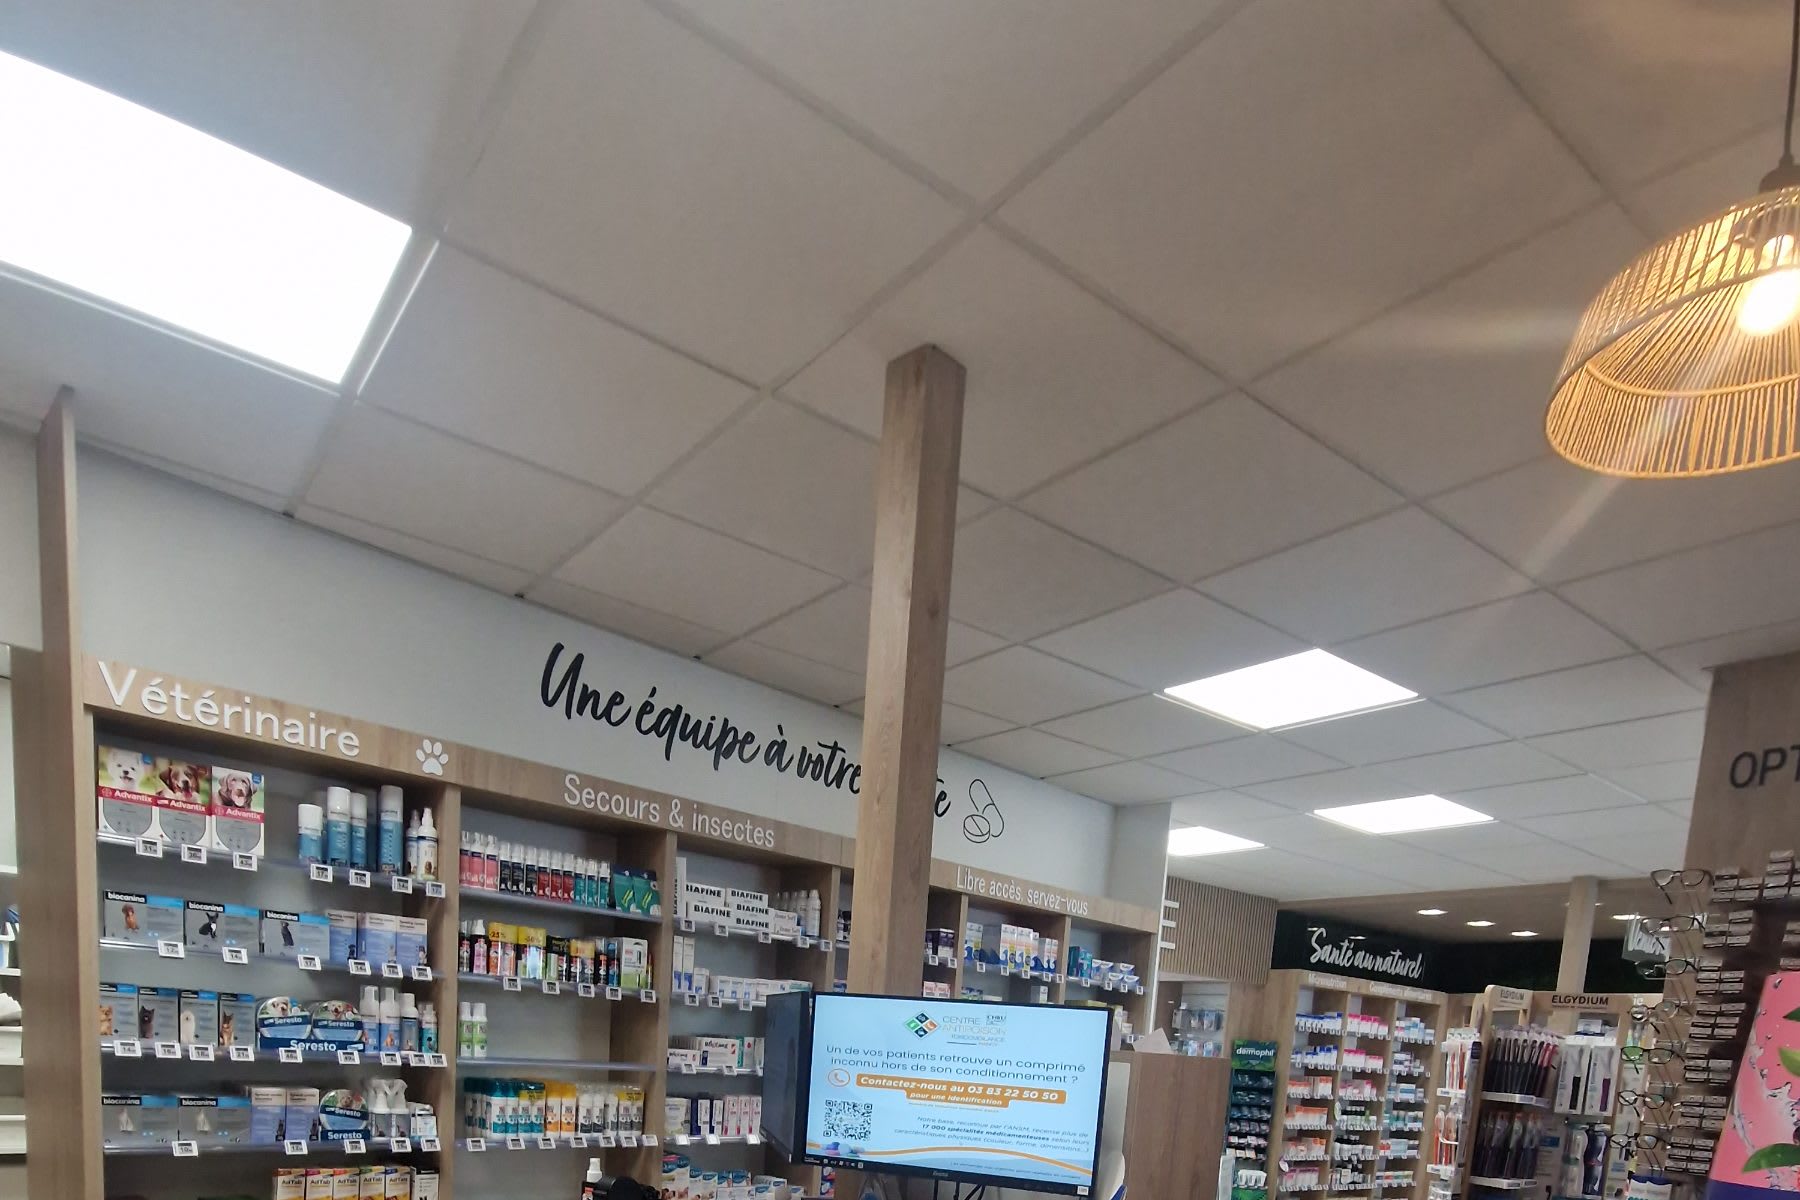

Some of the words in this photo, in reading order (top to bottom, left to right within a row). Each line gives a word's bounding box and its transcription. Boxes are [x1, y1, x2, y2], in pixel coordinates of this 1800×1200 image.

[98, 661, 361, 757] Vétérinaire
[541, 642, 632, 727] Une
[635, 686, 760, 771] équipe
[764, 724, 794, 773] à
[796, 740, 862, 794] votre
[114, 789, 153, 804] Advantix
[170, 799, 206, 813] Advantix
[564, 774, 660, 823] Secours
[669, 798, 685, 828] &
[692, 804, 775, 848] insectes
[225, 807, 261, 821] Advantix
[108, 891, 146, 903] biocanina
[731, 889, 764, 901] BIAFINE
[956, 866, 986, 892] Libre
[1027, 887, 1089, 916] servez-vous
[189, 902, 224, 913] biocanina
[693, 904, 731, 918] BIAFINE
[736, 903, 770, 916] BIAFINE
[266, 911, 298, 922] biocanina
[735, 917, 770, 929] BIAFINE
[1310, 928, 1355, 968] Santé
[1551, 994, 1609, 1006] ELGYDIUM
[274, 1016, 303, 1025] Seresto
[328, 1020, 355, 1028] Seresto
[942, 1015, 981, 1025] CENTRE
[290, 1039, 337, 1052] Seresto
[826, 1045, 841, 1054] Un
[844, 1045, 859, 1055] de
[863, 1048, 883, 1057] vos
[886, 1049, 936, 1061] patients
[939, 1054, 992, 1066] retrouve
[996, 1059, 1012, 1067] un
[1016, 1060, 1086, 1073] comprimé
[1236, 1047, 1275, 1058] dermophil
[831, 1056, 878, 1068] inconnu
[881, 1060, 907, 1071] hors
[910, 1063, 927, 1073] de
[930, 1066, 952, 1075] son
[955, 1066, 1067, 1083] conditionnement
[1071, 1075, 1078, 1084] ?
[860, 1076, 947, 1091] Contactez-nous
[950, 1085, 965, 1093] au
[967, 1085, 983, 1094] 03
[986, 1087, 1002, 1095] 83
[1004, 1089, 1020, 1097] 22
[1022, 1090, 1038, 1099] 50
[1041, 1091, 1059, 1101] 50
[103, 1097, 141, 1106] biocanina
[181, 1099, 217, 1107] biocanina
[909, 1092, 930, 1100] pour
[947, 1094, 1003, 1106] identification
[335, 1108, 361, 1118] Seresto
[327, 1131, 363, 1140] Seresto
[947, 1126, 984, 1135] spécialités
[985, 1130, 1050, 1141] médicamenteuses
